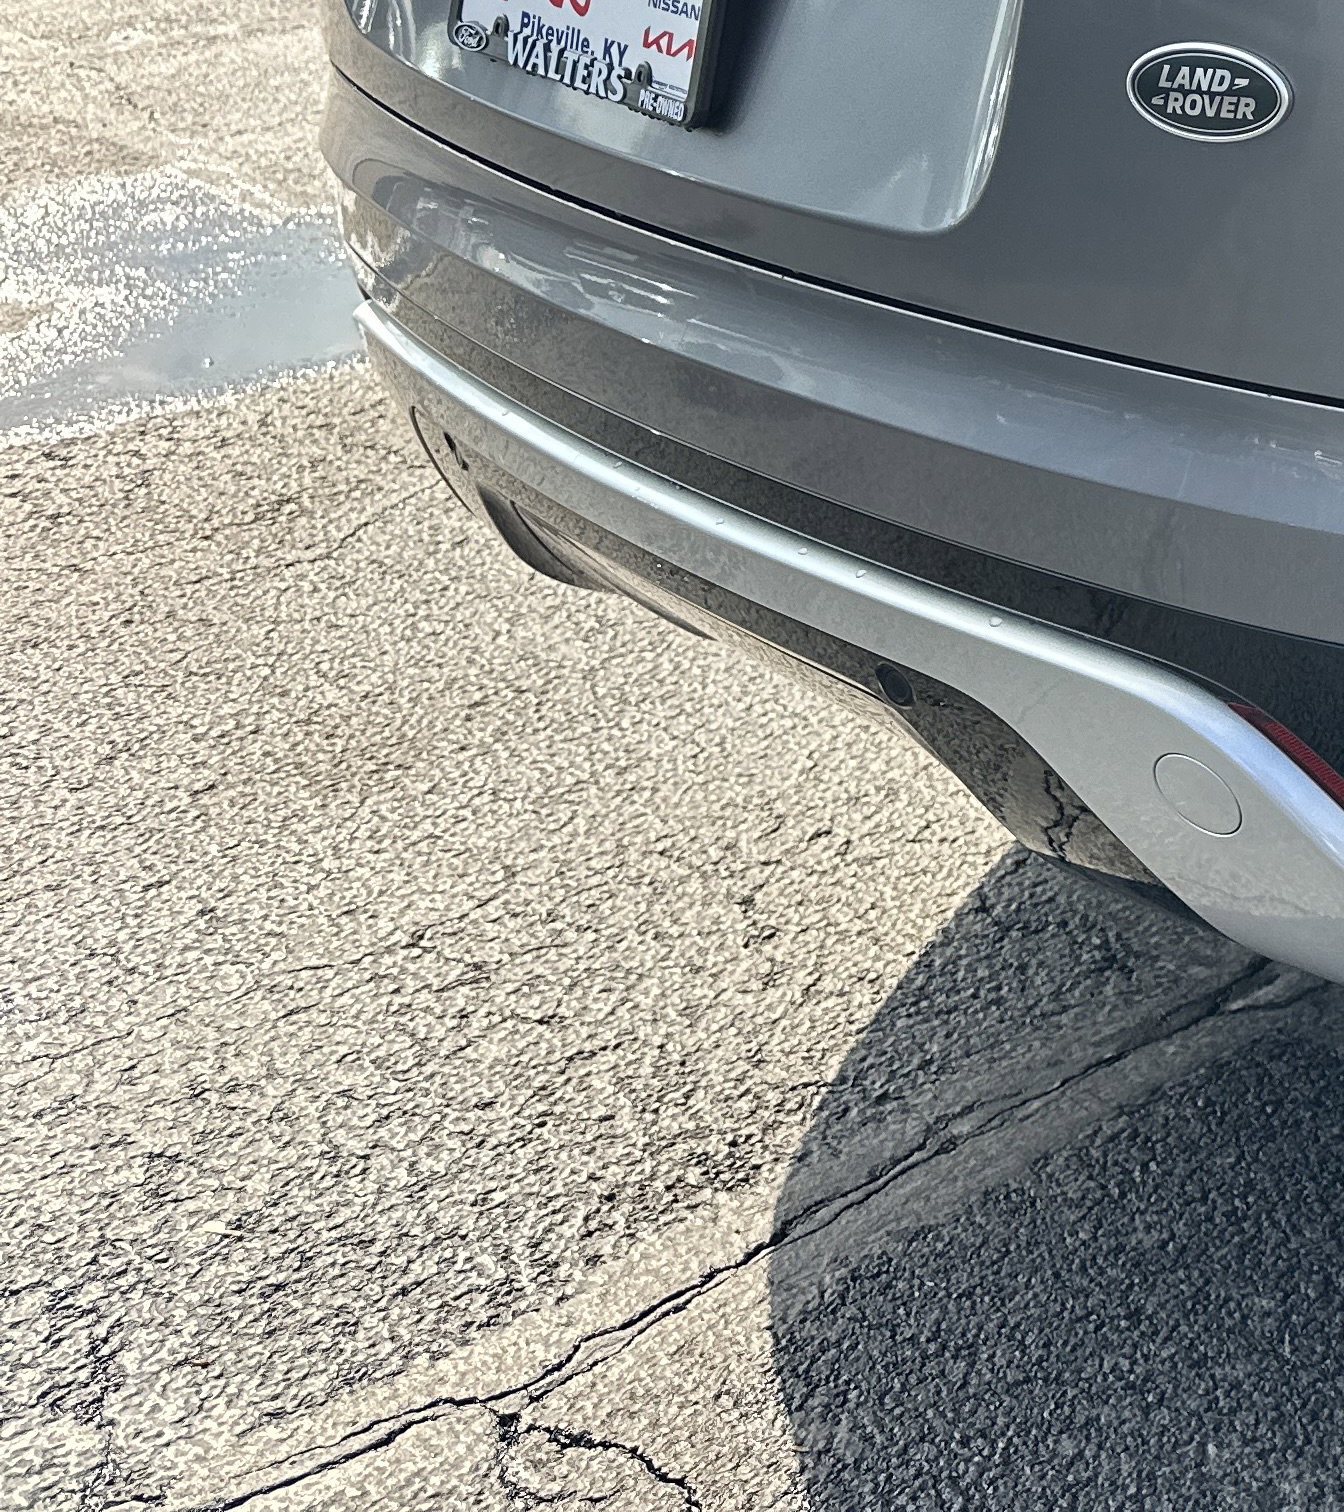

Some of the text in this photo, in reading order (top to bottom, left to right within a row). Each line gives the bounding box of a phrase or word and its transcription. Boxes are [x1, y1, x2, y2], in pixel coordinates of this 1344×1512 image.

[507, 30, 626, 102] WALTERS
[604, 37, 629, 67] KY
[1158, 64, 1232, 92] LAND
[638, 89, 685, 121] PRE-OWNED
[1166, 91, 1256, 120] ROVER
